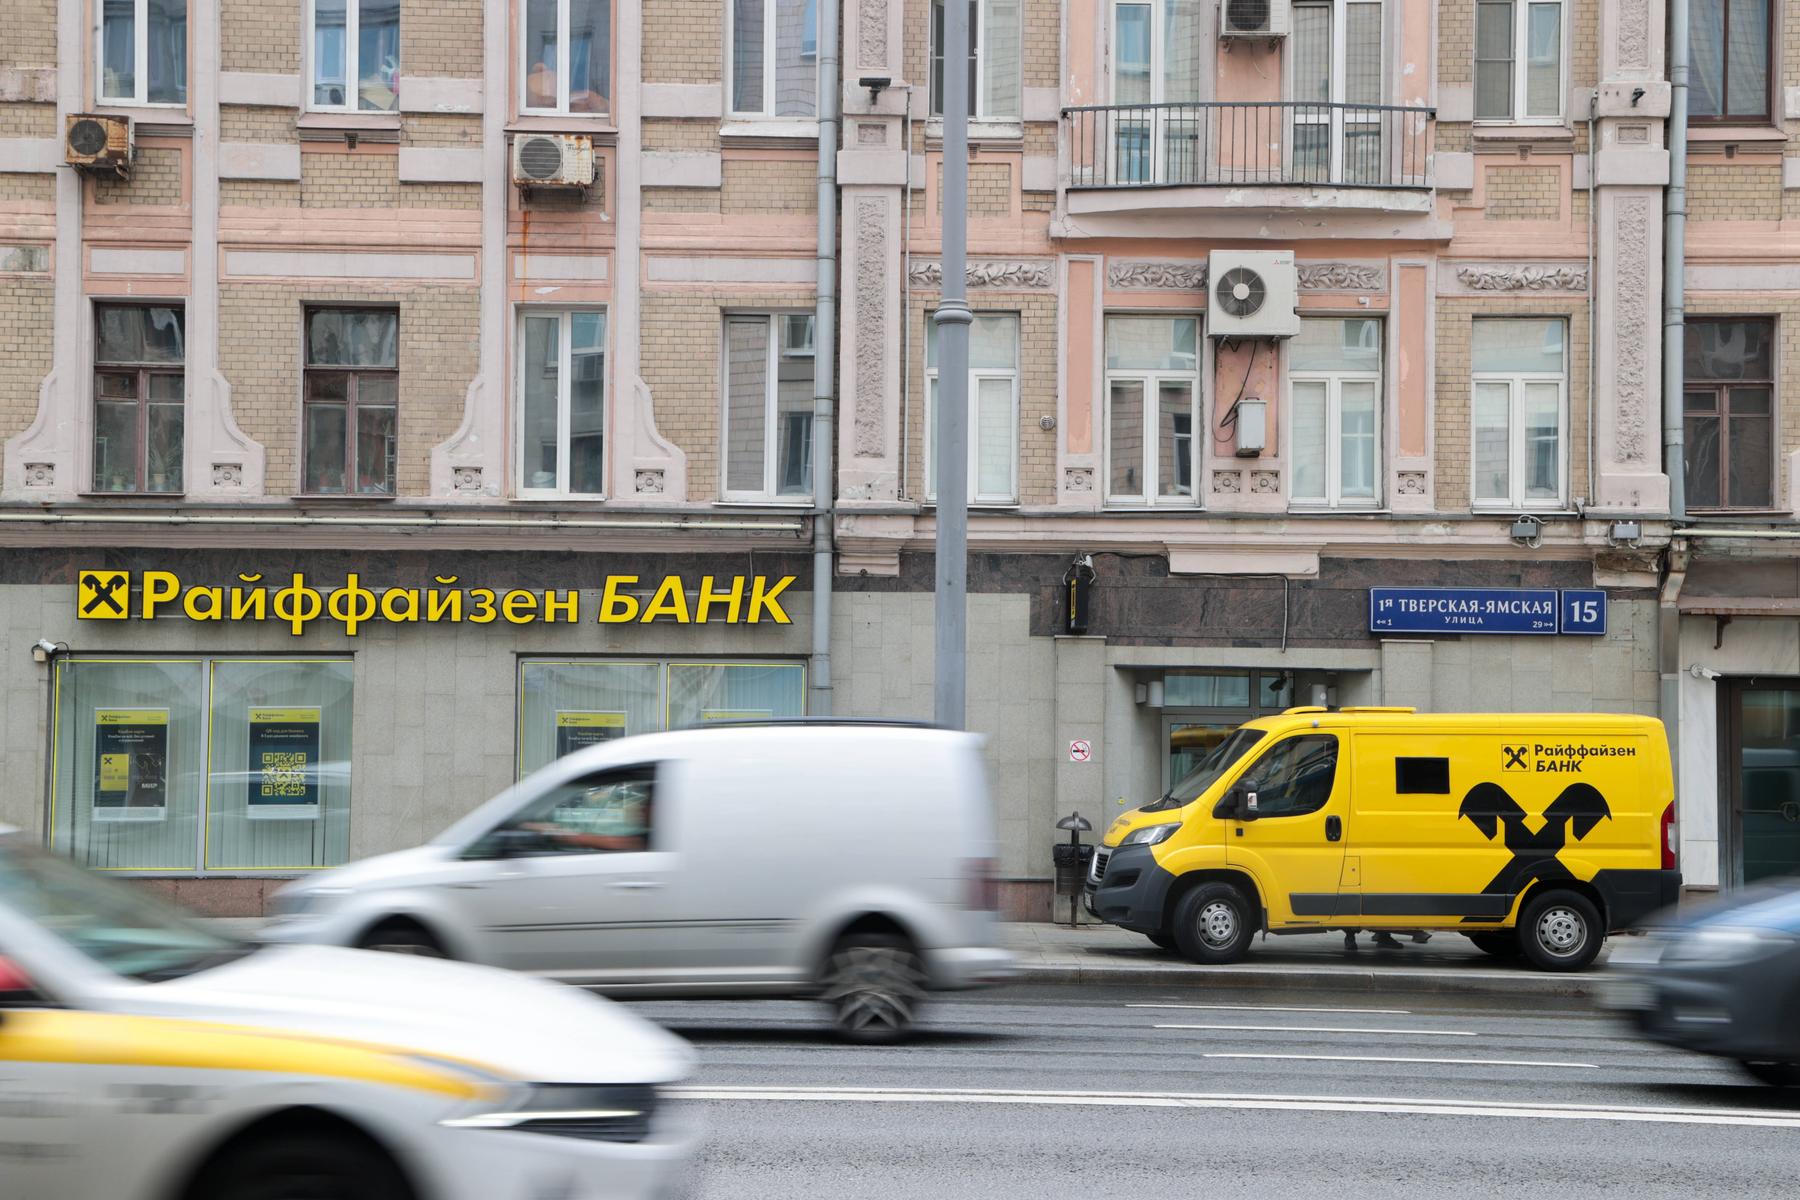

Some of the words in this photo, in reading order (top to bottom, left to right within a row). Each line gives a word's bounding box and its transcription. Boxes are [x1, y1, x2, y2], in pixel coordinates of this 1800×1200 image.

[142, 570, 580, 636] Райффайзен
[598, 574, 798, 625] БАНК
[1399, 599, 1552, 614] ТВЕРСКАЯ-ЯМСКАЯ
[1571, 601, 1598, 623] 15
[1444, 616, 1484, 625] УЛИЦА
[1532, 620, 1543, 628] 29
[1534, 744, 1636, 759] Райффайзен
[1536, 760, 1582, 773] БАНК
